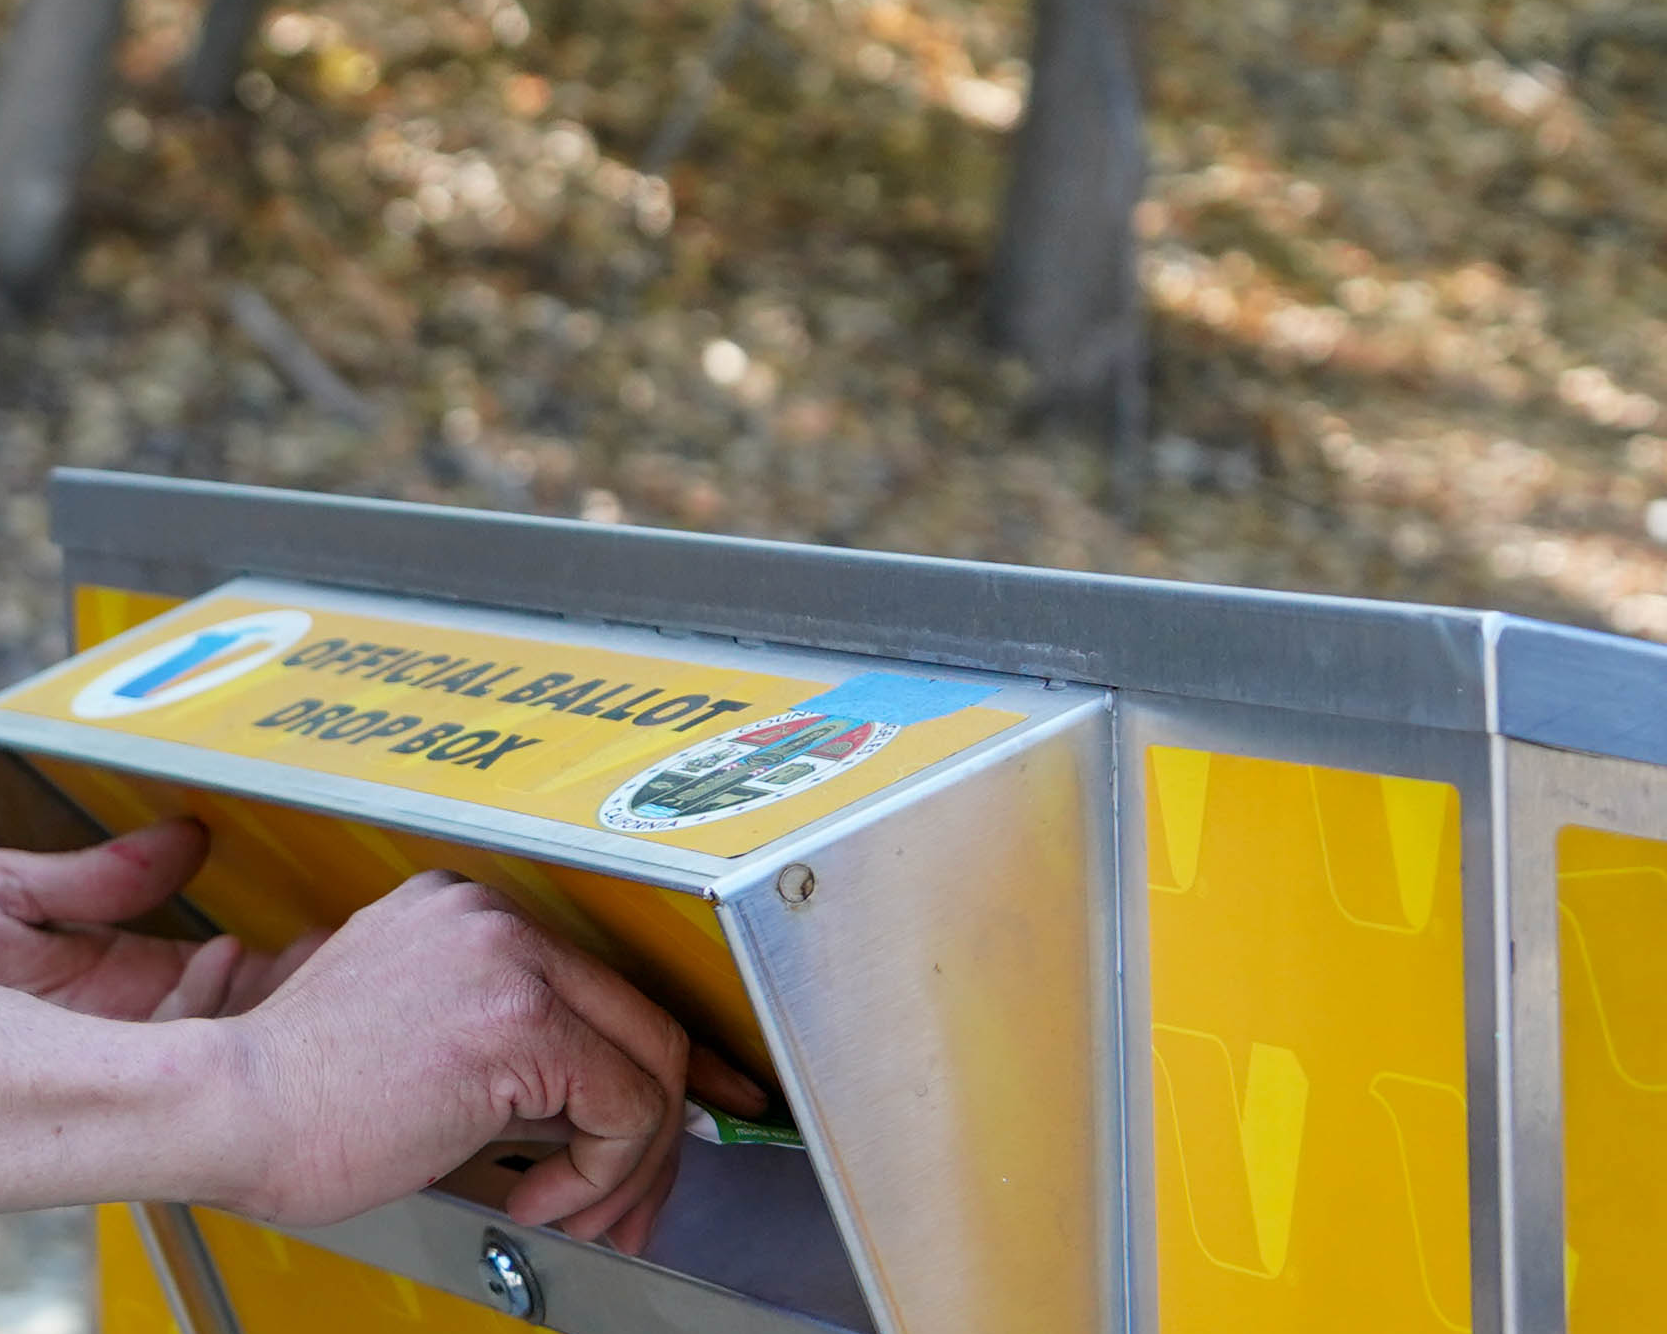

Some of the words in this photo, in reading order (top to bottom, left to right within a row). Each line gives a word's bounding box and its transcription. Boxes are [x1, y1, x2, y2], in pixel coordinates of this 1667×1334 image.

[282, 638, 522, 697] OFFICIAL
[498, 671, 754, 733] BALLOT
[253, 698, 423, 745] DROP
[389, 722, 544, 770] BOX
